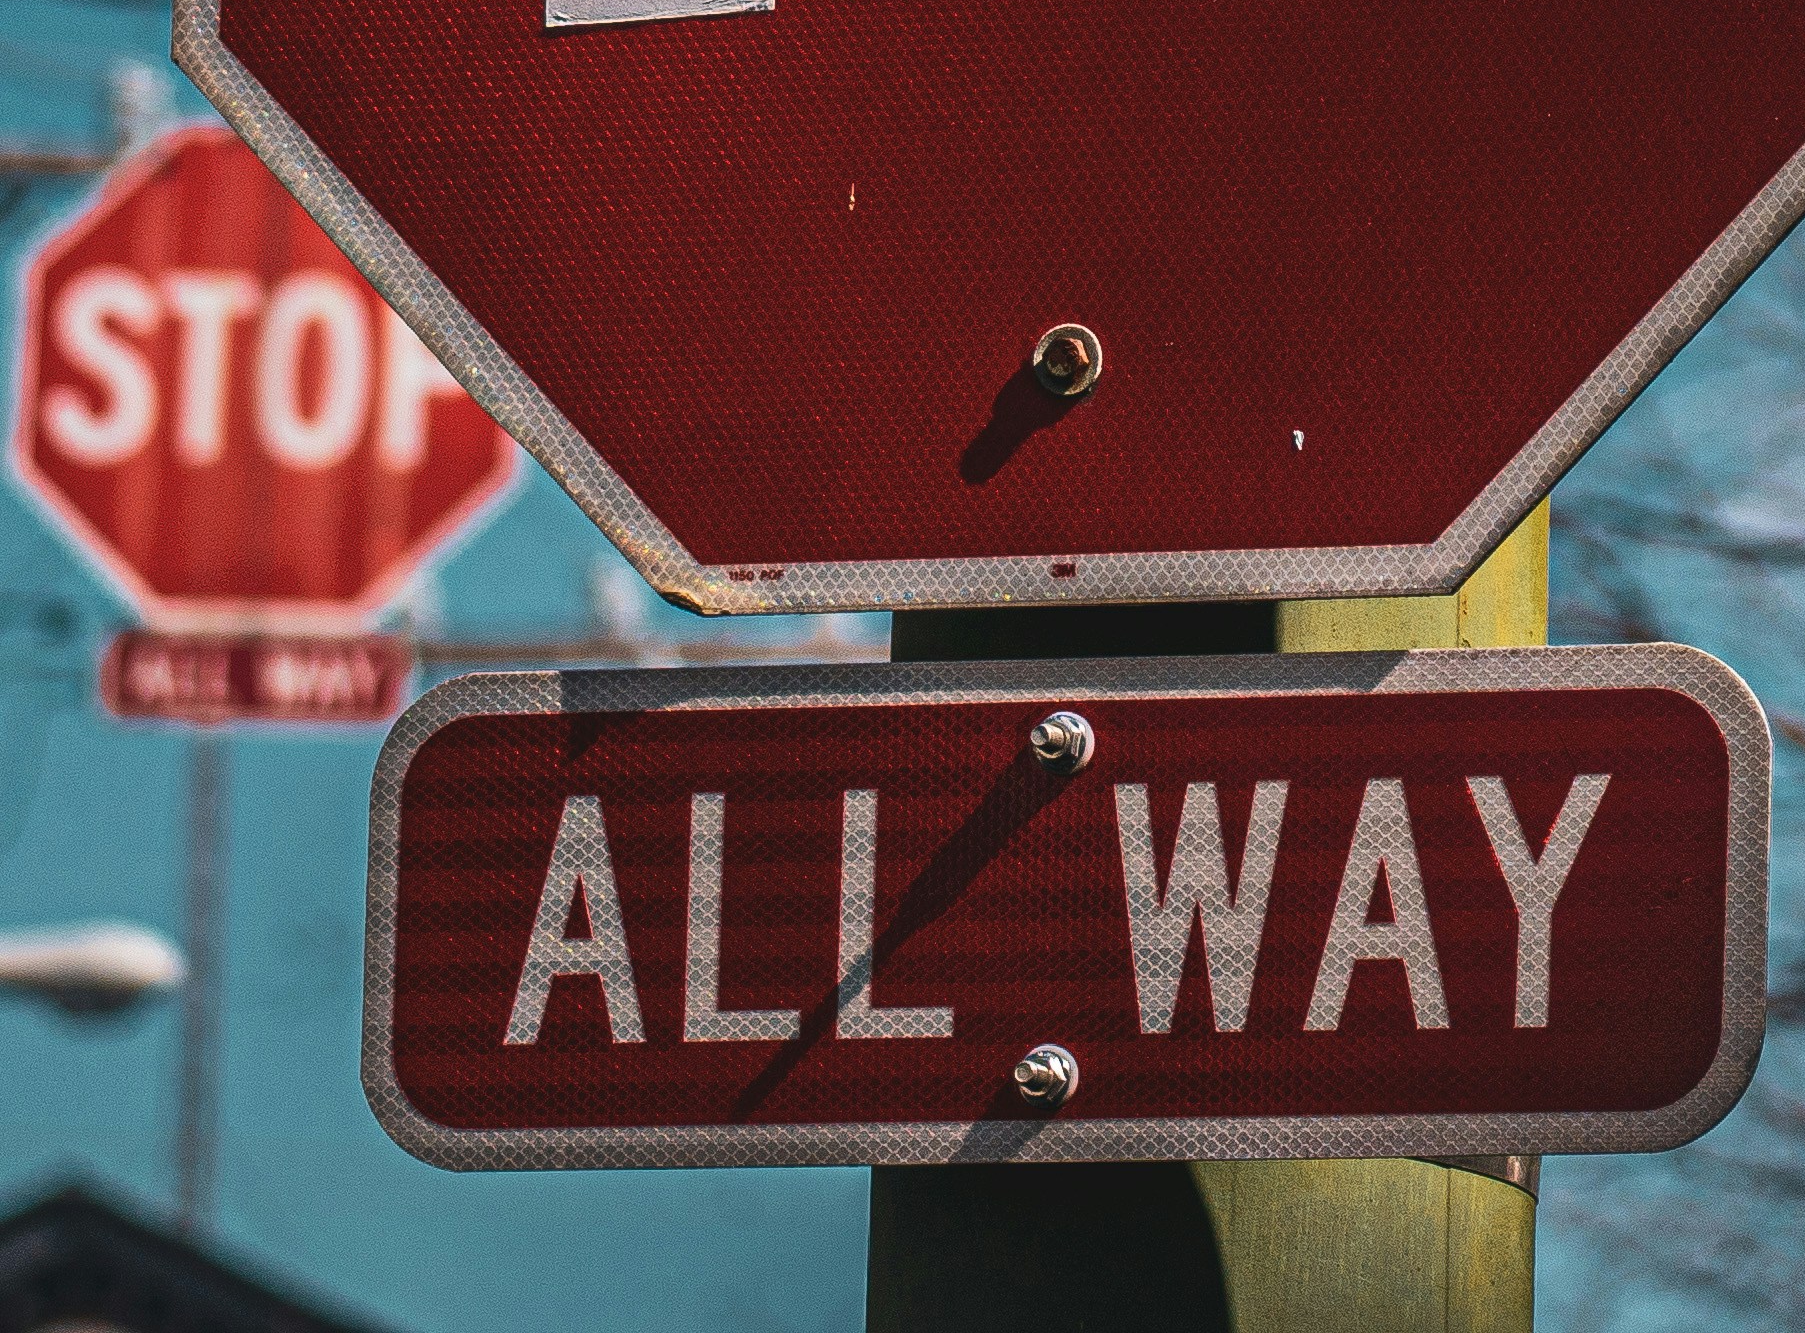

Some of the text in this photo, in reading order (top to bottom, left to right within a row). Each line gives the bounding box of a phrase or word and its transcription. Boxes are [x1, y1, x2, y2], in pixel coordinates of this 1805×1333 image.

[1050, 561, 1078, 579] 3M
[502, 773, 1612, 1046] ALL WAY
